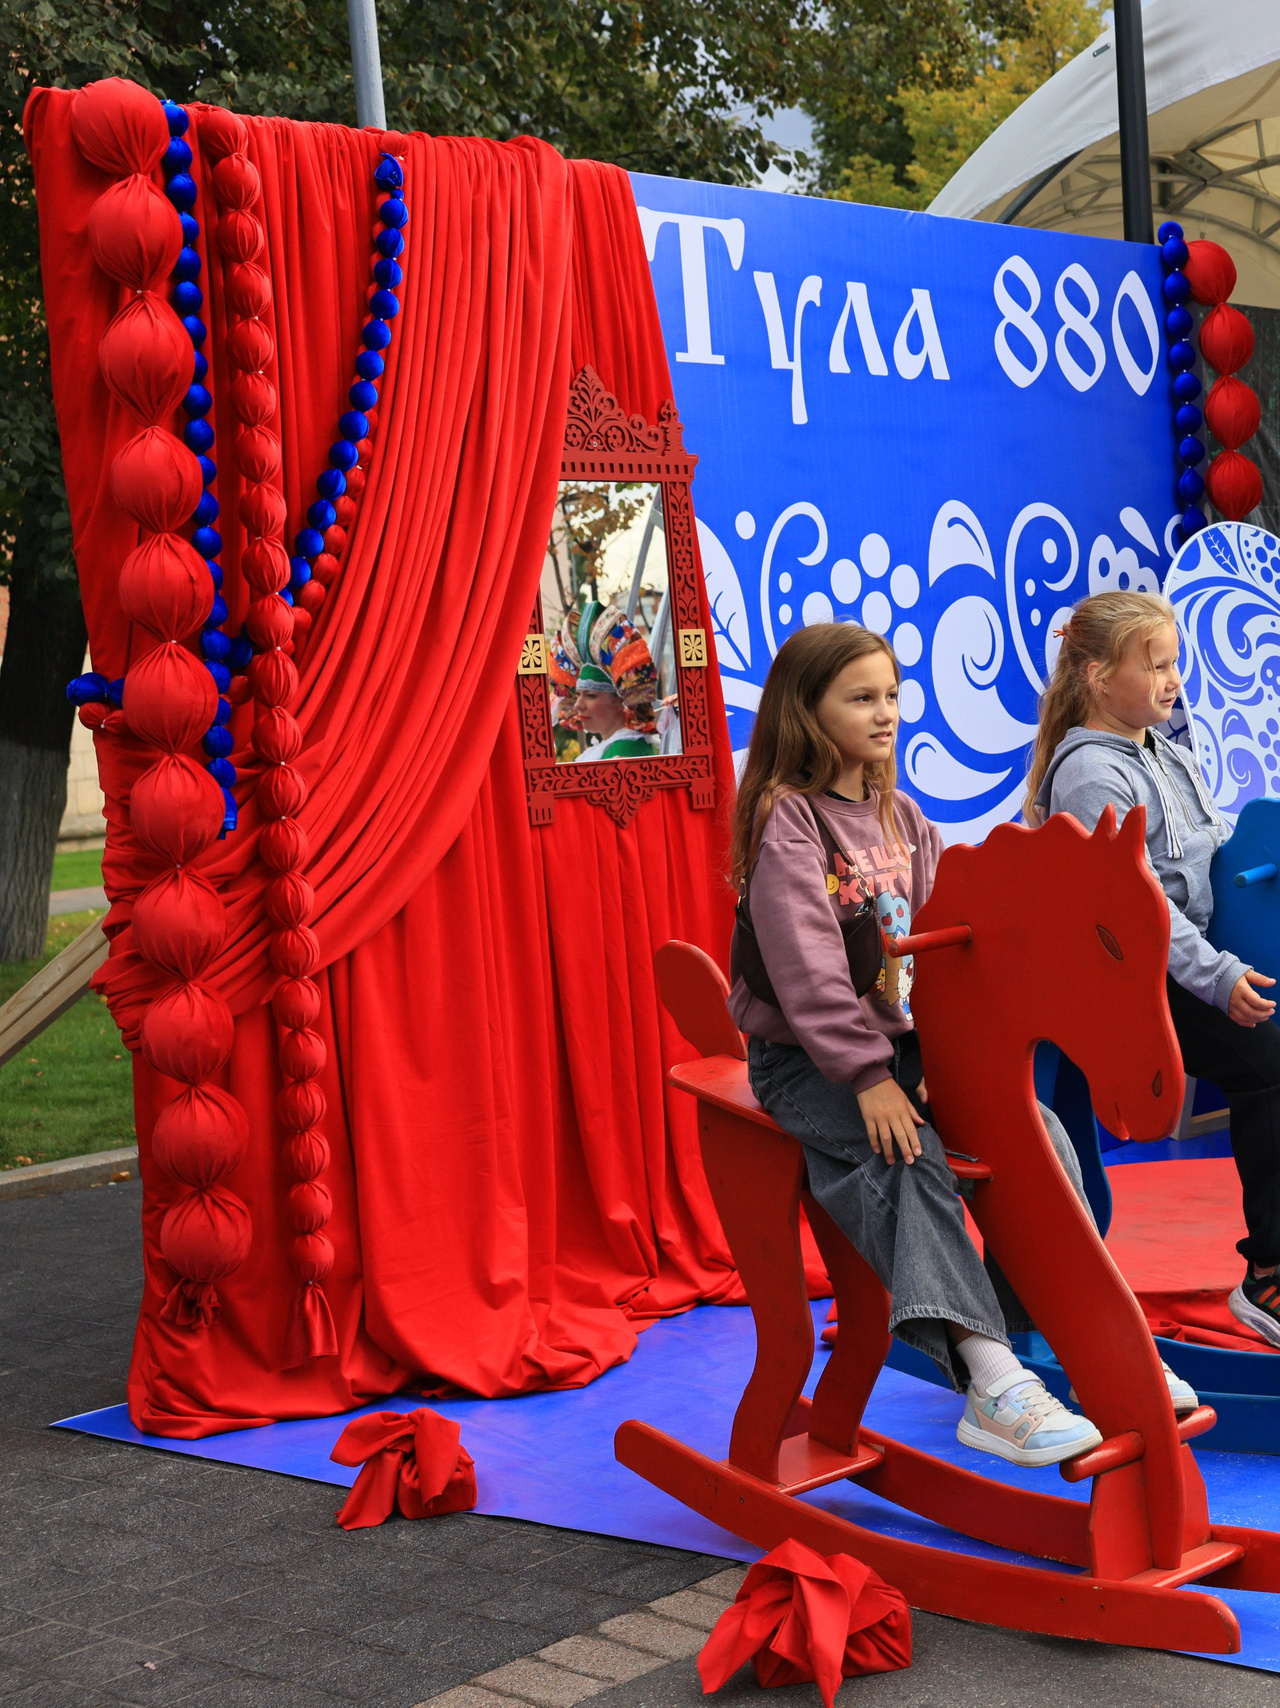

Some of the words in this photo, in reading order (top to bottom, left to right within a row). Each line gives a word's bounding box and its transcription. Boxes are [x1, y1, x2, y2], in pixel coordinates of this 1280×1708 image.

[637, 206, 949, 424] Тула
[994, 255, 1159, 396] 880
[833, 842, 911, 877] HELLO
[839, 871, 912, 906] KITTY
